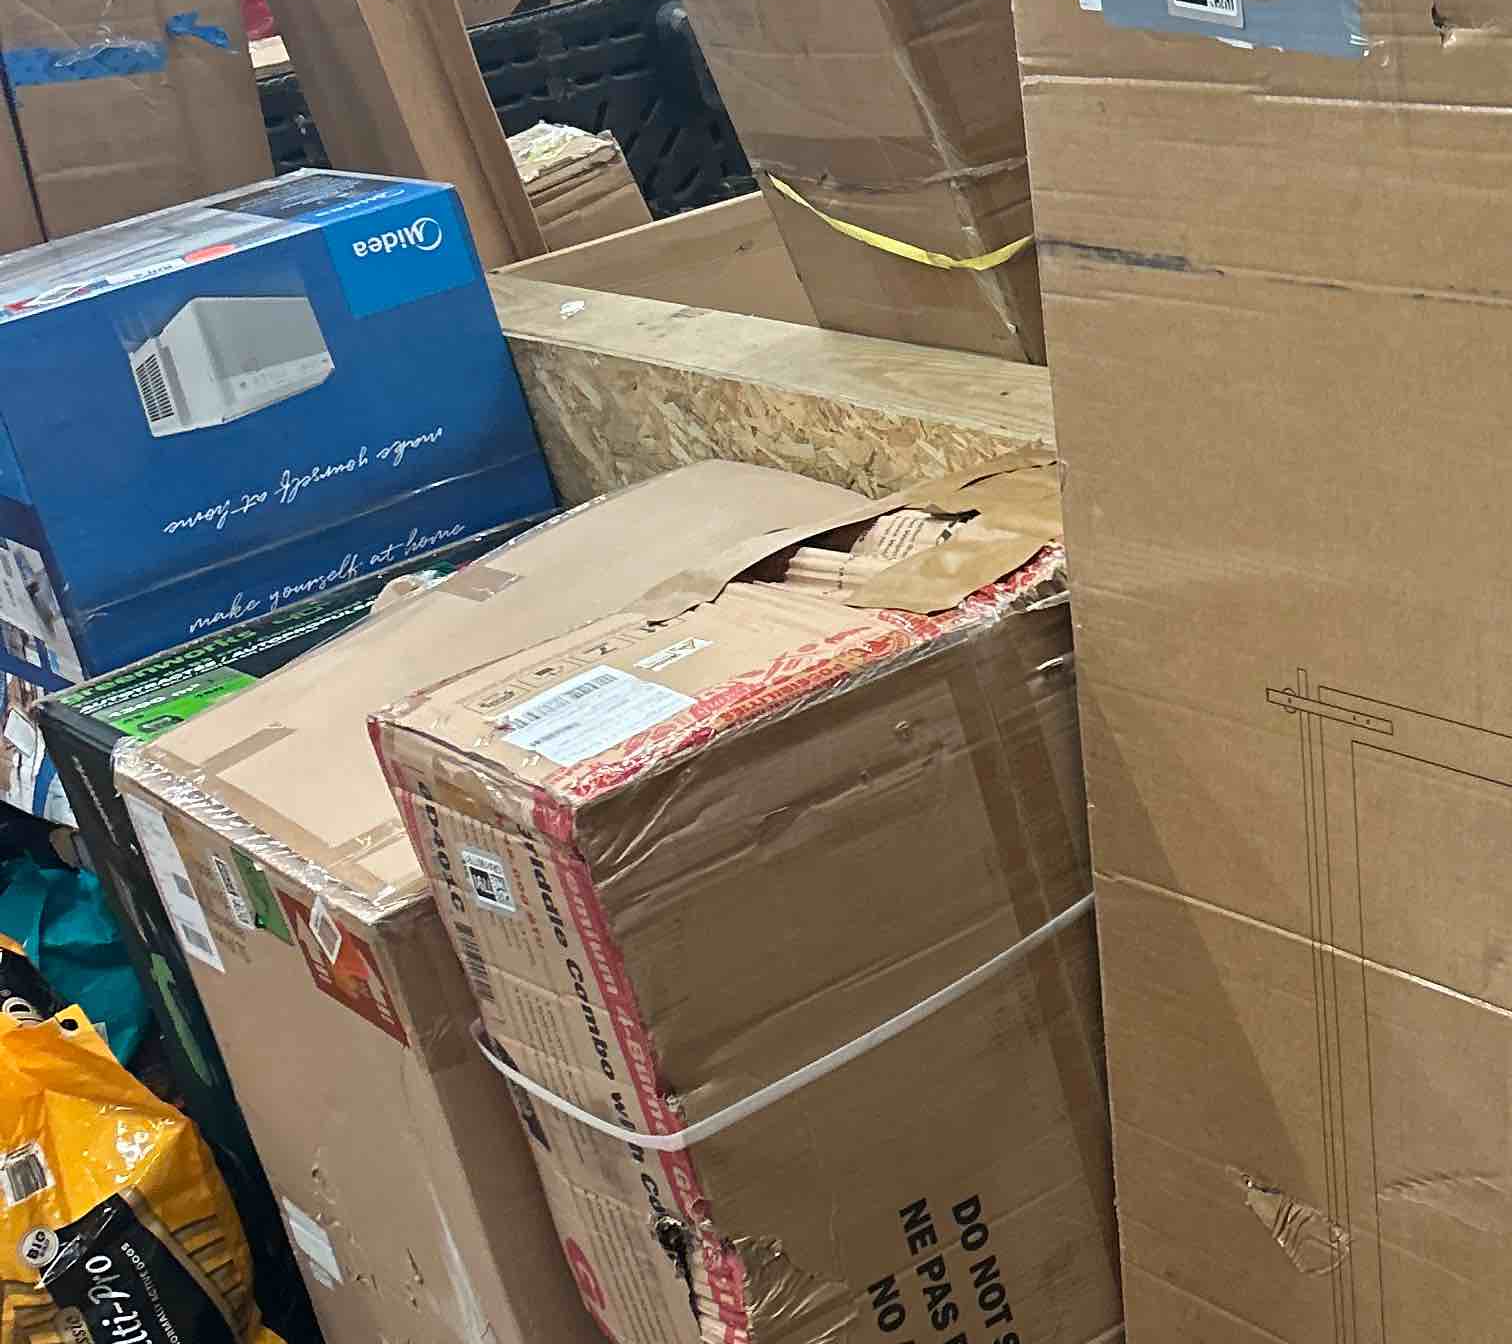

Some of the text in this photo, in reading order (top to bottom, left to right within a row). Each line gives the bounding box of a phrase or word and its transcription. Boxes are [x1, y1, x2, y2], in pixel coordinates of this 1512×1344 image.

[352, 217, 442, 258] Midea
[163, 427, 444, 535] make yourself at home
[189, 594, 262, 635] make
[269, 561, 364, 609] yourself
[369, 543, 401, 567] at
[404, 522, 467, 555] home
[566, 957, 616, 1082] Combo
[27, 1231, 46, 1259] BIG
[901, 1197, 935, 1254] NE
[950, 1194, 990, 1253] DO
[868, 1273, 907, 1334] NO
[917, 1256, 959, 1332] PAS
[967, 1255, 1015, 1330] NOT
